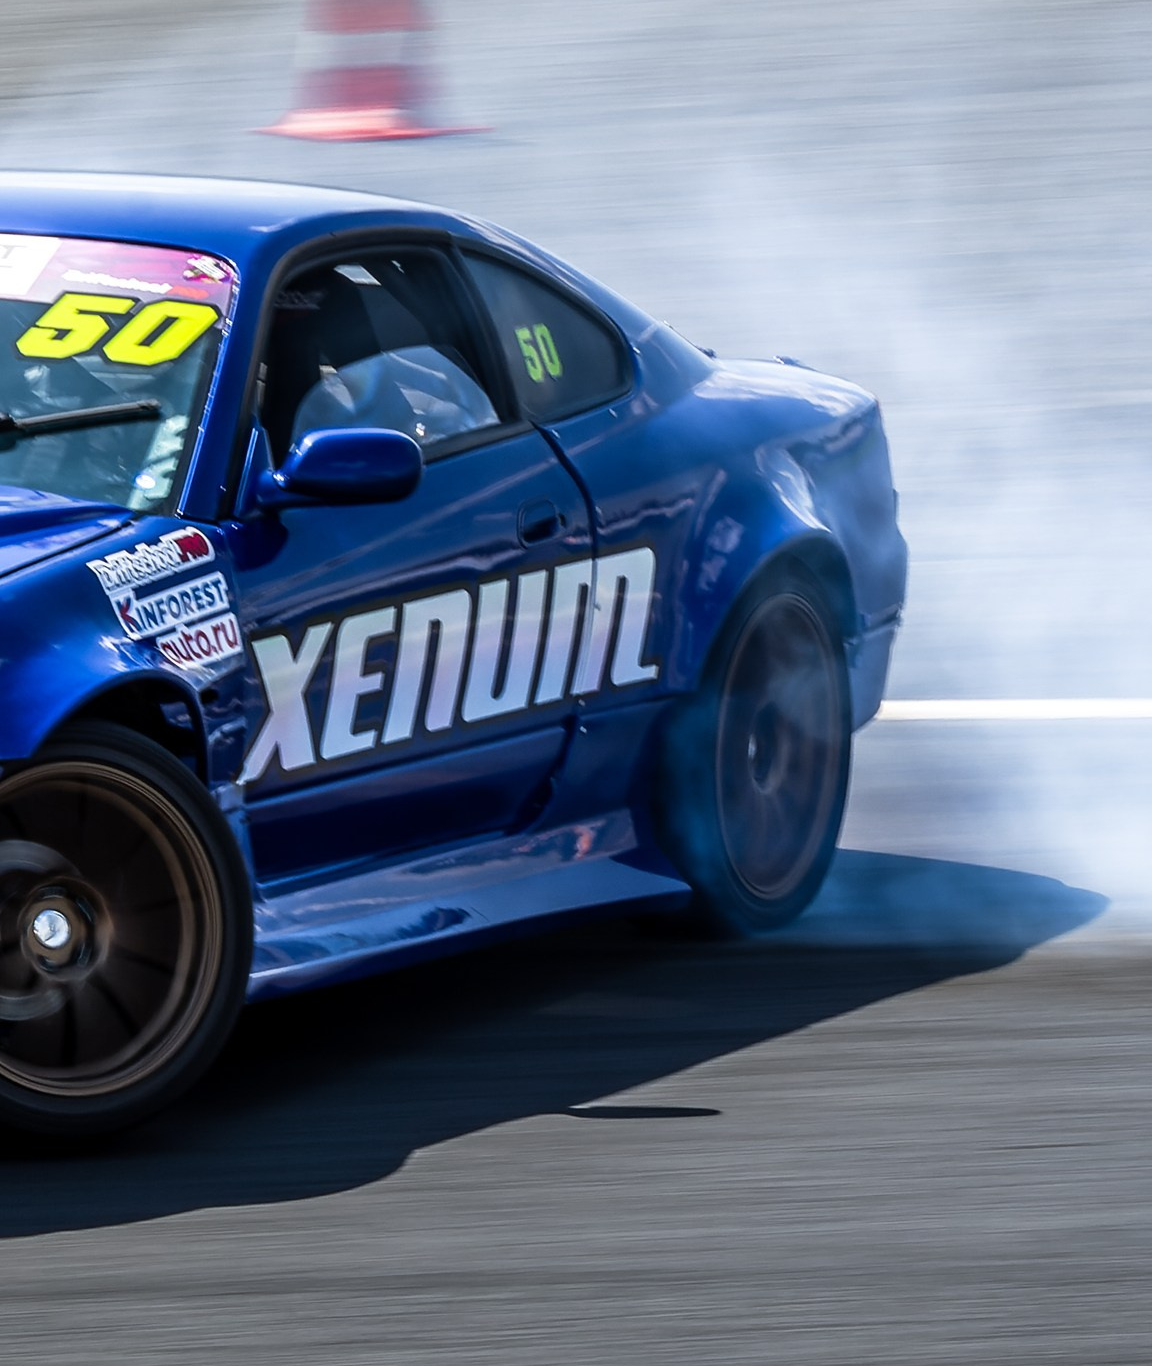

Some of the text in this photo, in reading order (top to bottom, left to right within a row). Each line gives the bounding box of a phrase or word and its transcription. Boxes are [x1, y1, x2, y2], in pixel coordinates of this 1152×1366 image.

[14, 291, 220, 367] 50
[514, 322, 564, 384] 50
[114, 579, 227, 633] KINFOREST
[160, 618, 240, 664] auto.ru
[236, 547, 659, 786] XENUM
